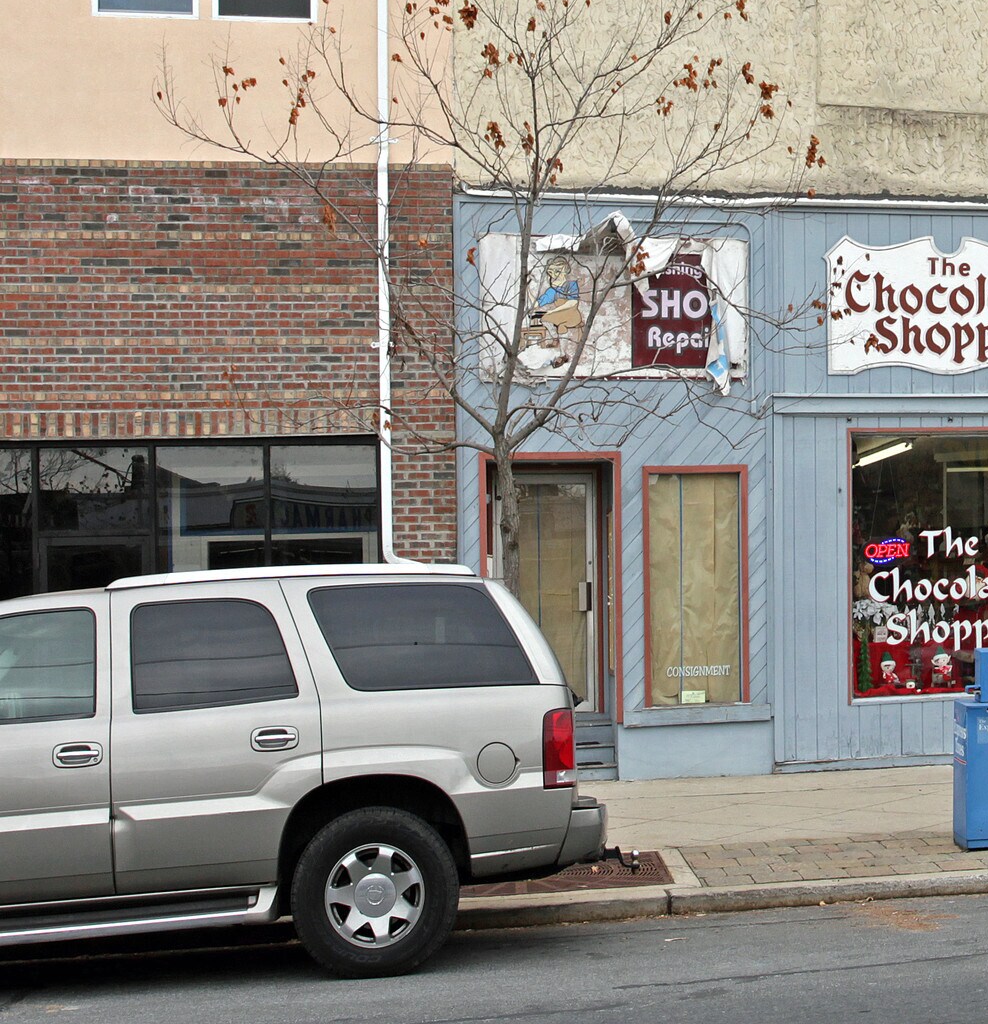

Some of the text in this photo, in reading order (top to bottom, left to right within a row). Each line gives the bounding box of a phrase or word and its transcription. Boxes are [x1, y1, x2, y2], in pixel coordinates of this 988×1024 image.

[927, 256, 971, 277] The
[641, 289, 708, 319] SHO
[647, 326, 710, 354] Repai
[864, 543, 911, 559] OPEN
[919, 526, 979, 559] The
[666, 664, 731, 678] CONSIGNMENT
